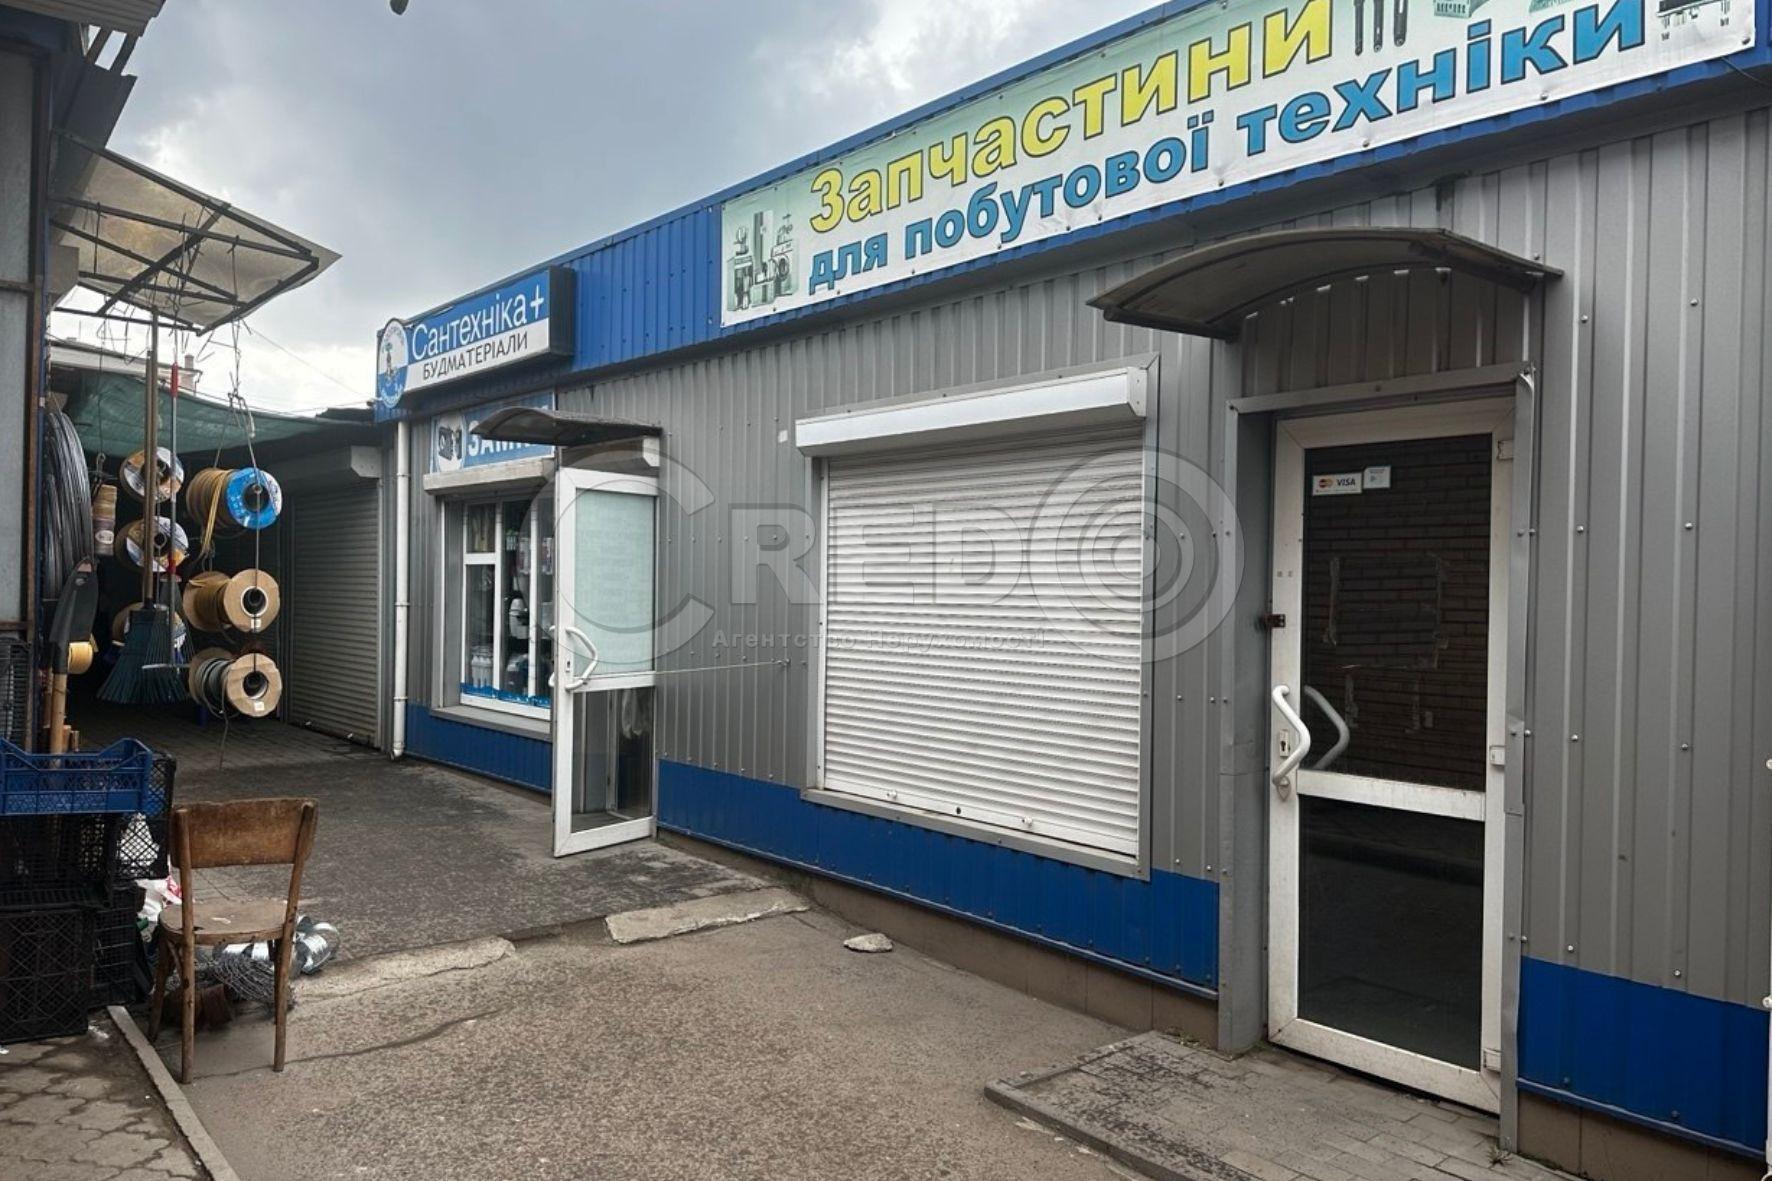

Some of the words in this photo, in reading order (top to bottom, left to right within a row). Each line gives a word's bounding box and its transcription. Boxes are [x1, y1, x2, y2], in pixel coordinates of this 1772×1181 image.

[809, 0, 1332, 233] Запчастини
[809, 233, 888, 295] для
[904, 109, 1210, 260] побутової
[1236, 0, 1646, 157] техніки
[422, 331, 528, 381] БУДМАТЕРІАЛИ
[1337, 478, 1356, 487] VISA
